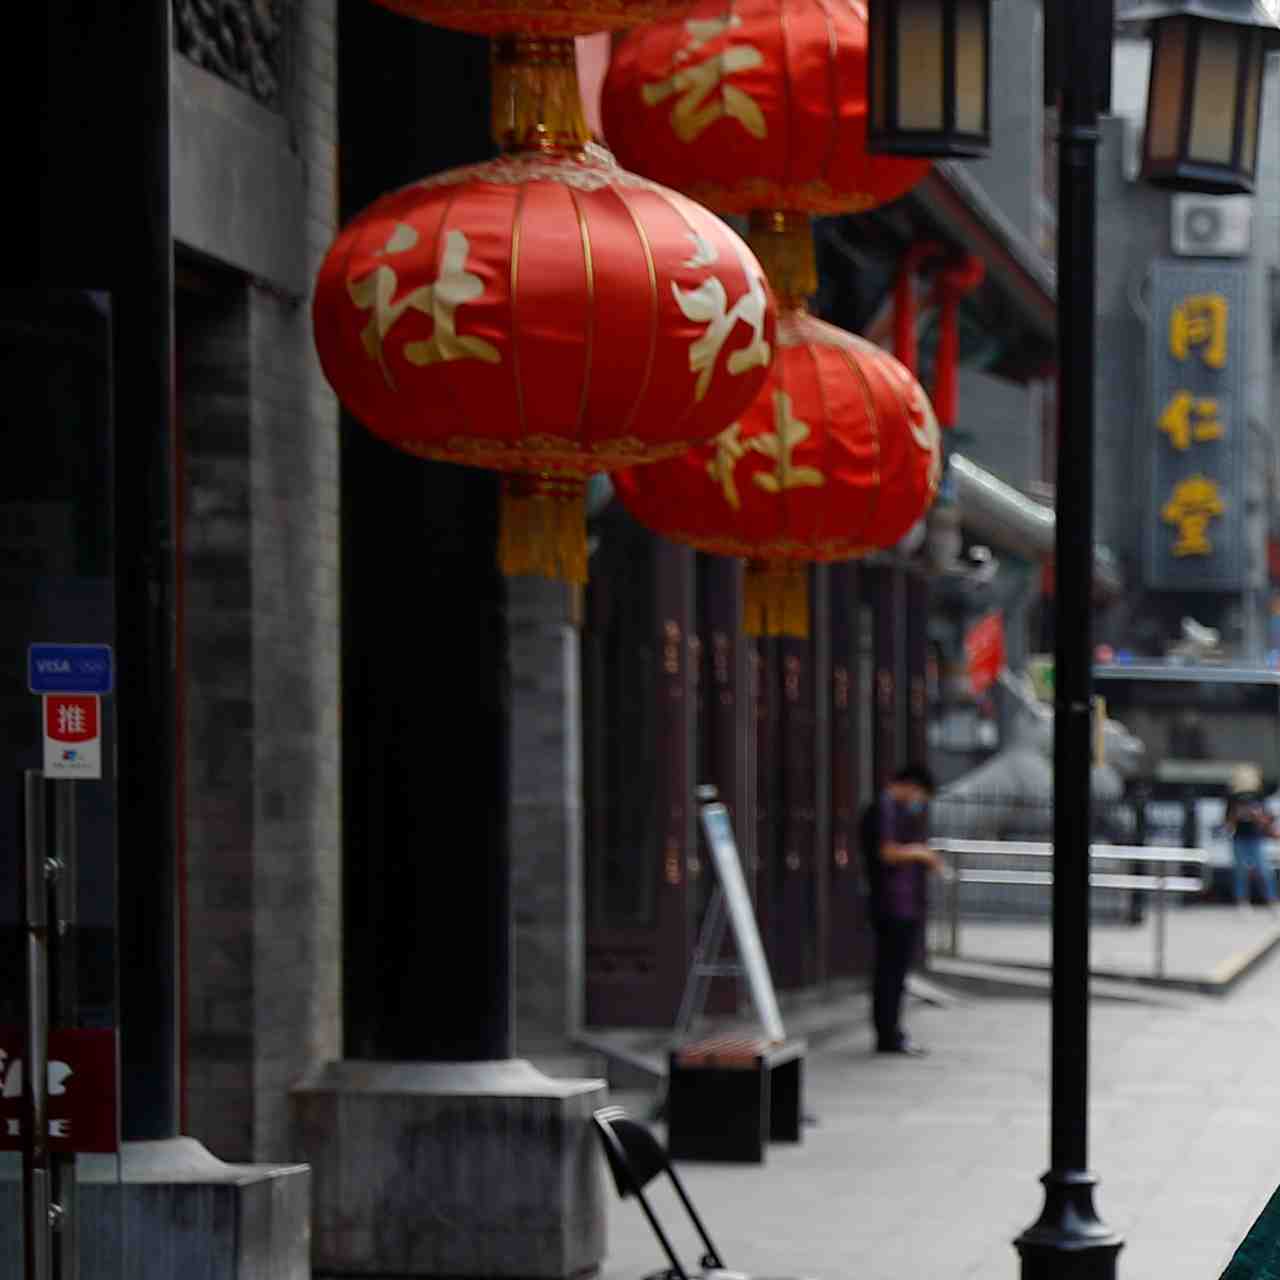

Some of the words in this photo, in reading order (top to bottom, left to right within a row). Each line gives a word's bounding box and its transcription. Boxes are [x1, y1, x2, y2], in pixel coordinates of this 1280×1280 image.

[347, 223, 501, 393] 社
[1158, 293, 1229, 556] 同仁堂
[36, 659, 72, 673] VISA
